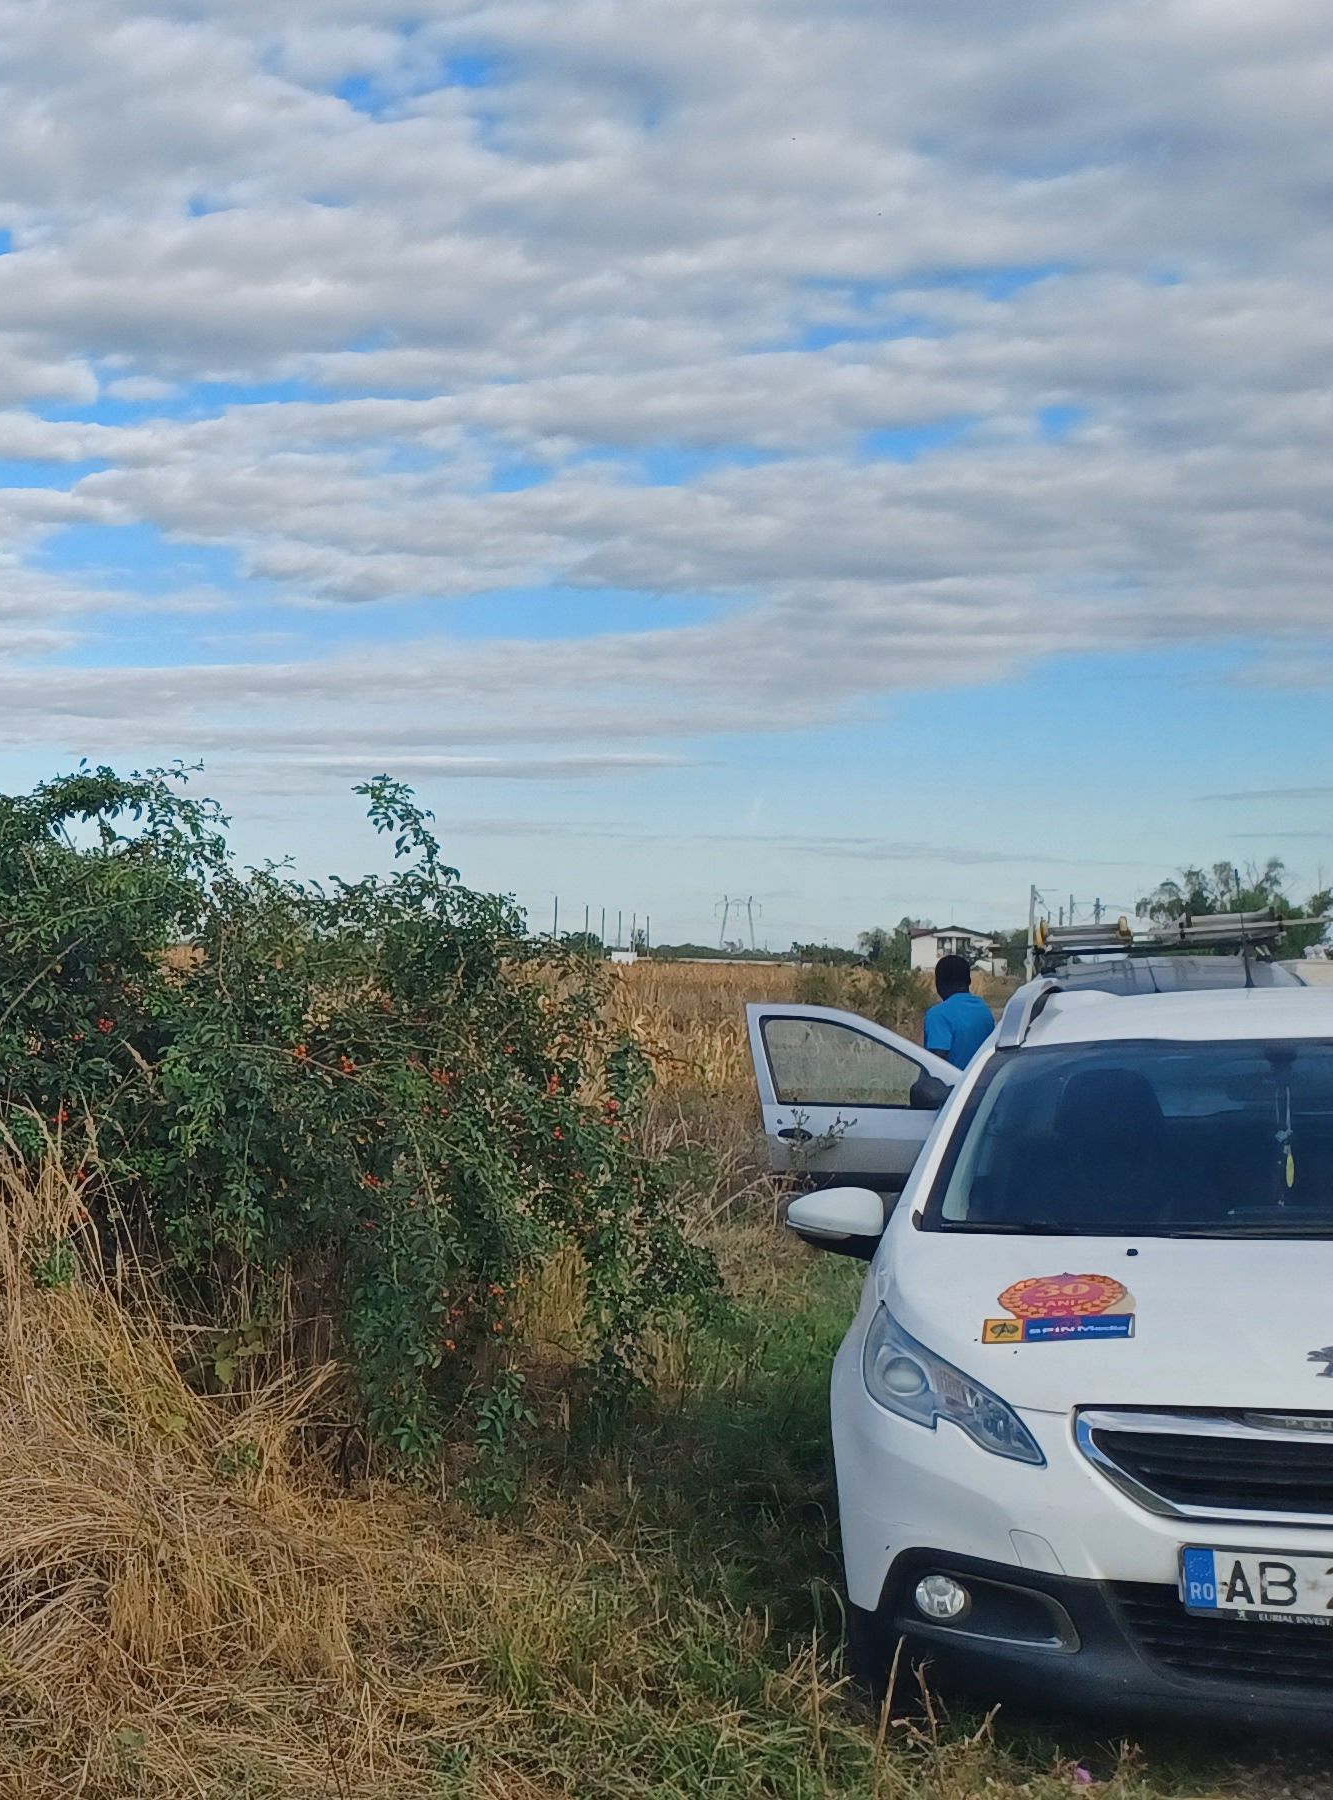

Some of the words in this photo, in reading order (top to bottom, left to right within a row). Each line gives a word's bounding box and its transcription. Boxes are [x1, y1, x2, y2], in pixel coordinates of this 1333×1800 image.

[1034, 1283, 1090, 1298] 30
[1189, 1581, 1214, 1601] RO
[1225, 1560, 1298, 1606] AB
